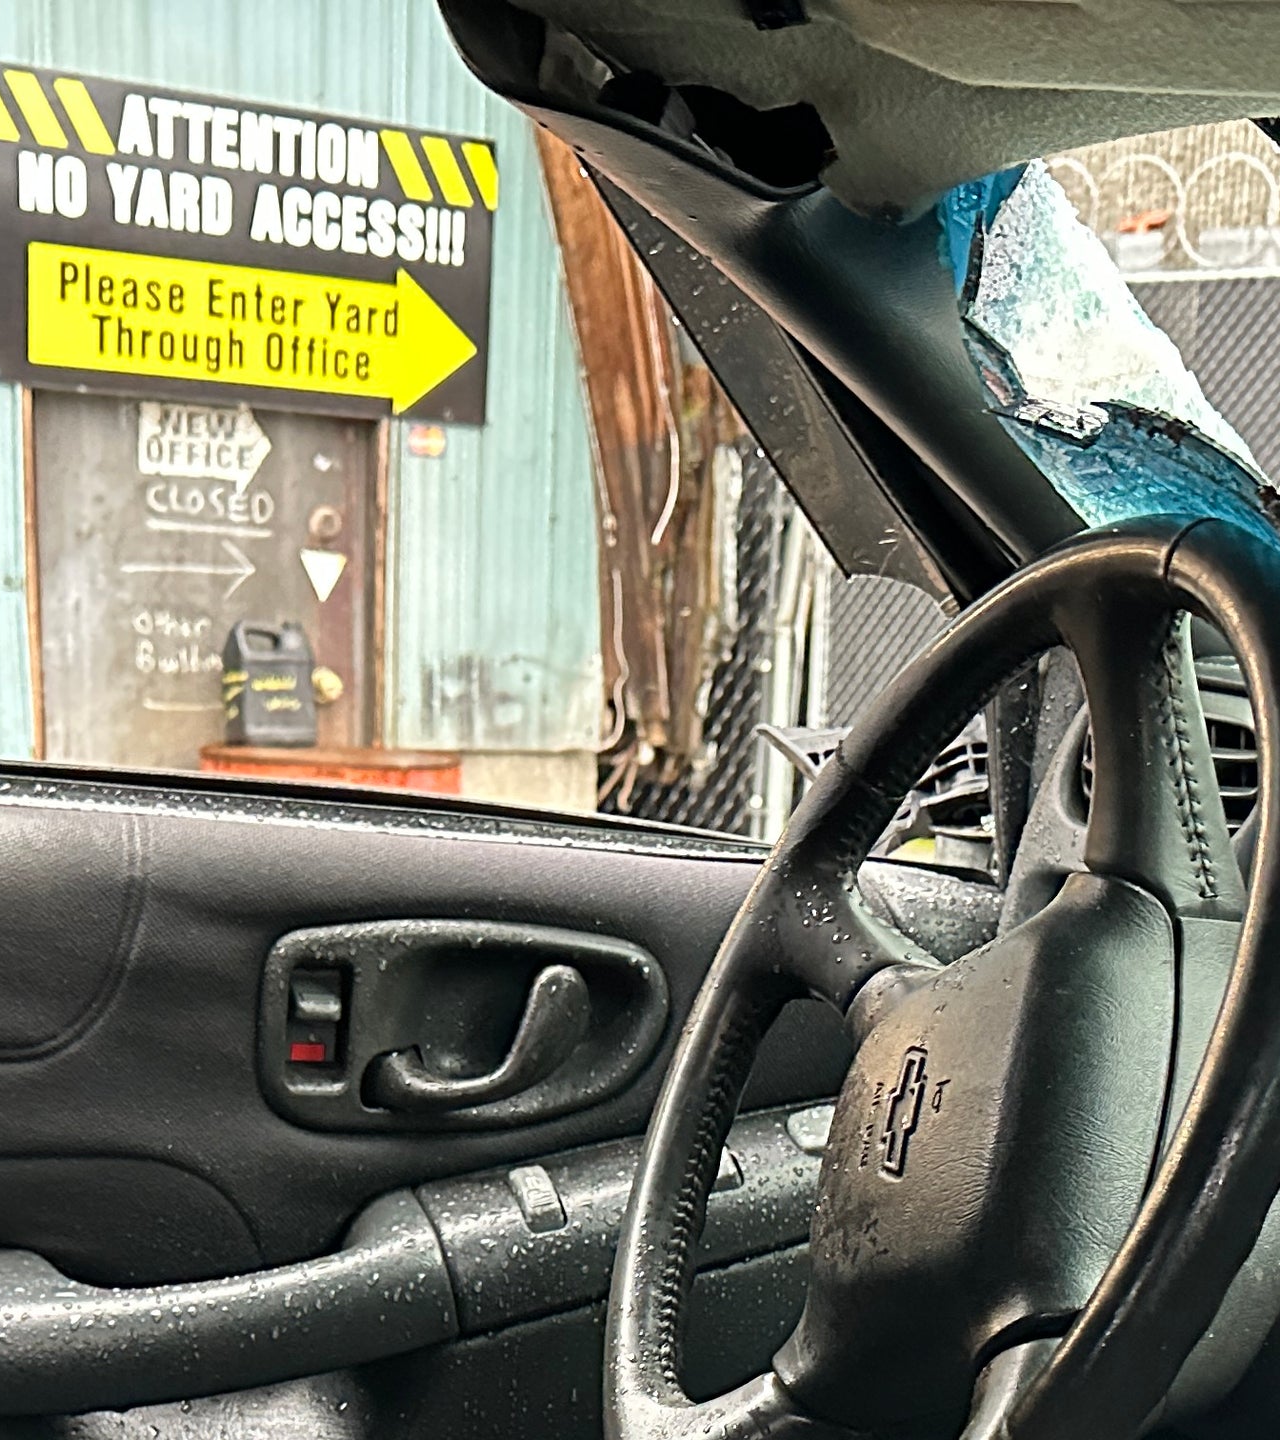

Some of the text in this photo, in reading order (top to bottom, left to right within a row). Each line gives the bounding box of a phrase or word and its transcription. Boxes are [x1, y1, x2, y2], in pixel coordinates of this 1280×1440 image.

[118, 93, 379, 189] ATTENTION
[18, 150, 466, 267] NO YARD ACCESS!!!
[60, 261, 399, 337] Please Enter Yard
[92, 313, 370, 381] Through Office
[146, 434, 253, 471] OFFICE
[146, 482, 275, 524] CLOSED
